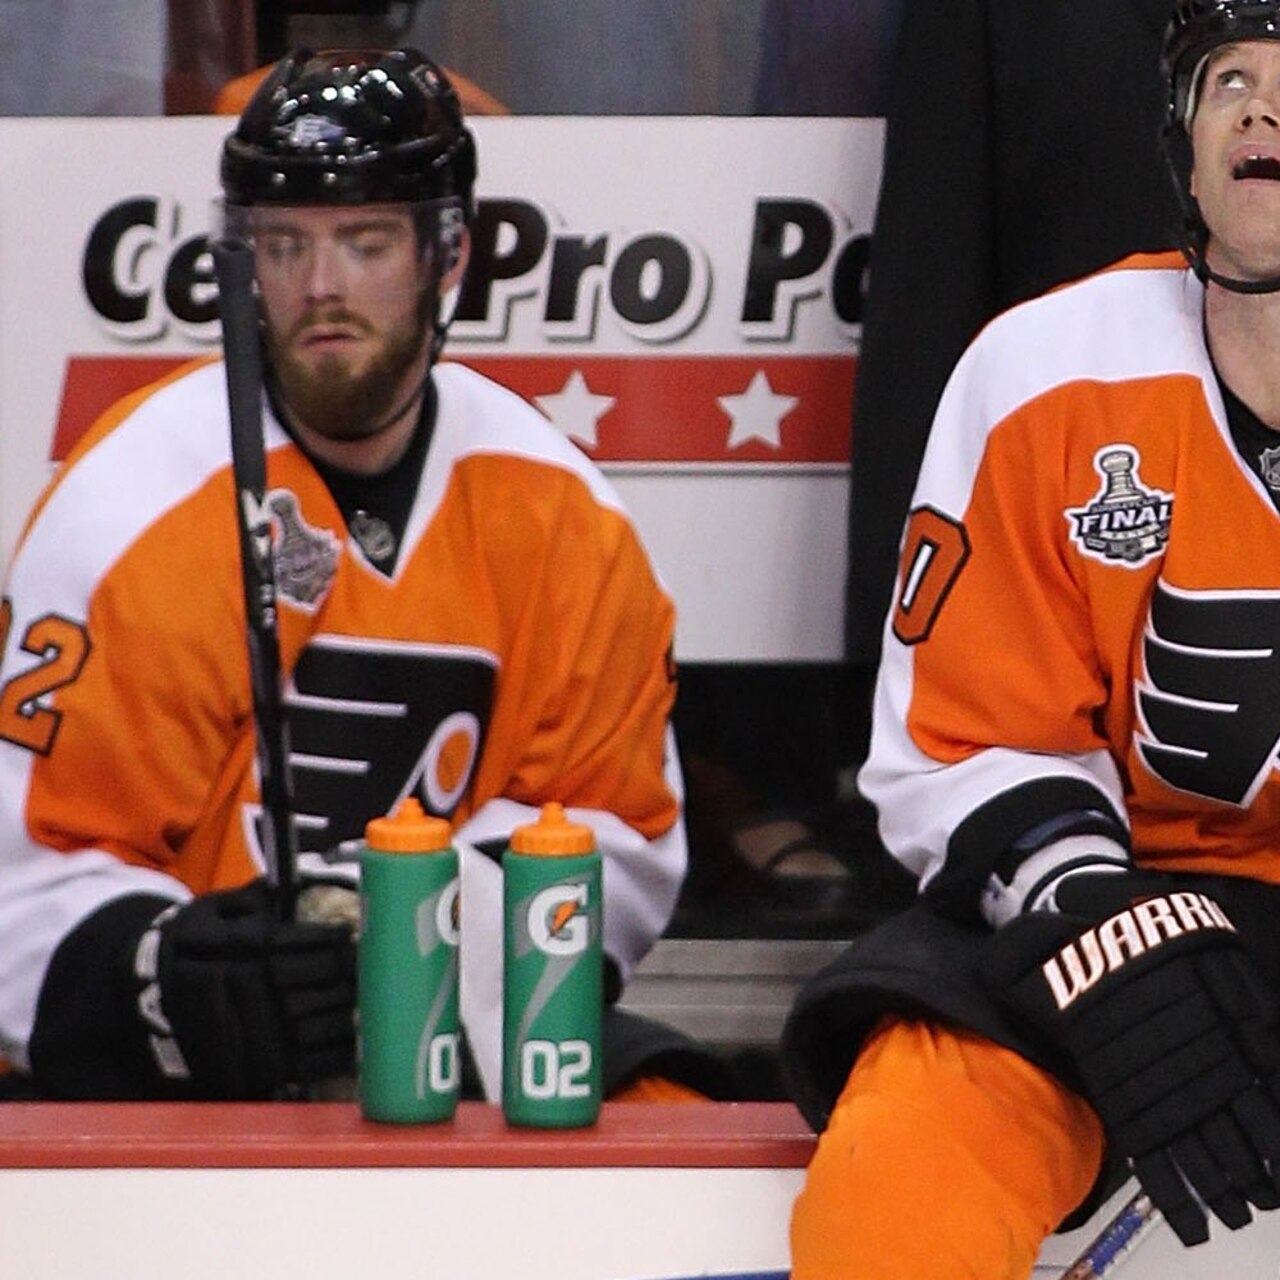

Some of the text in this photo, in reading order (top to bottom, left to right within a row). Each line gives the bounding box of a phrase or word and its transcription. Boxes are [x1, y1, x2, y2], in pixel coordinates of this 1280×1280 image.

[1081, 504, 1172, 533] FINAL
[0, 594, 92, 756] 2
[528, 884, 588, 955] G
[1043, 892, 1238, 1011] WARRI
[521, 1039, 592, 1099] 02
